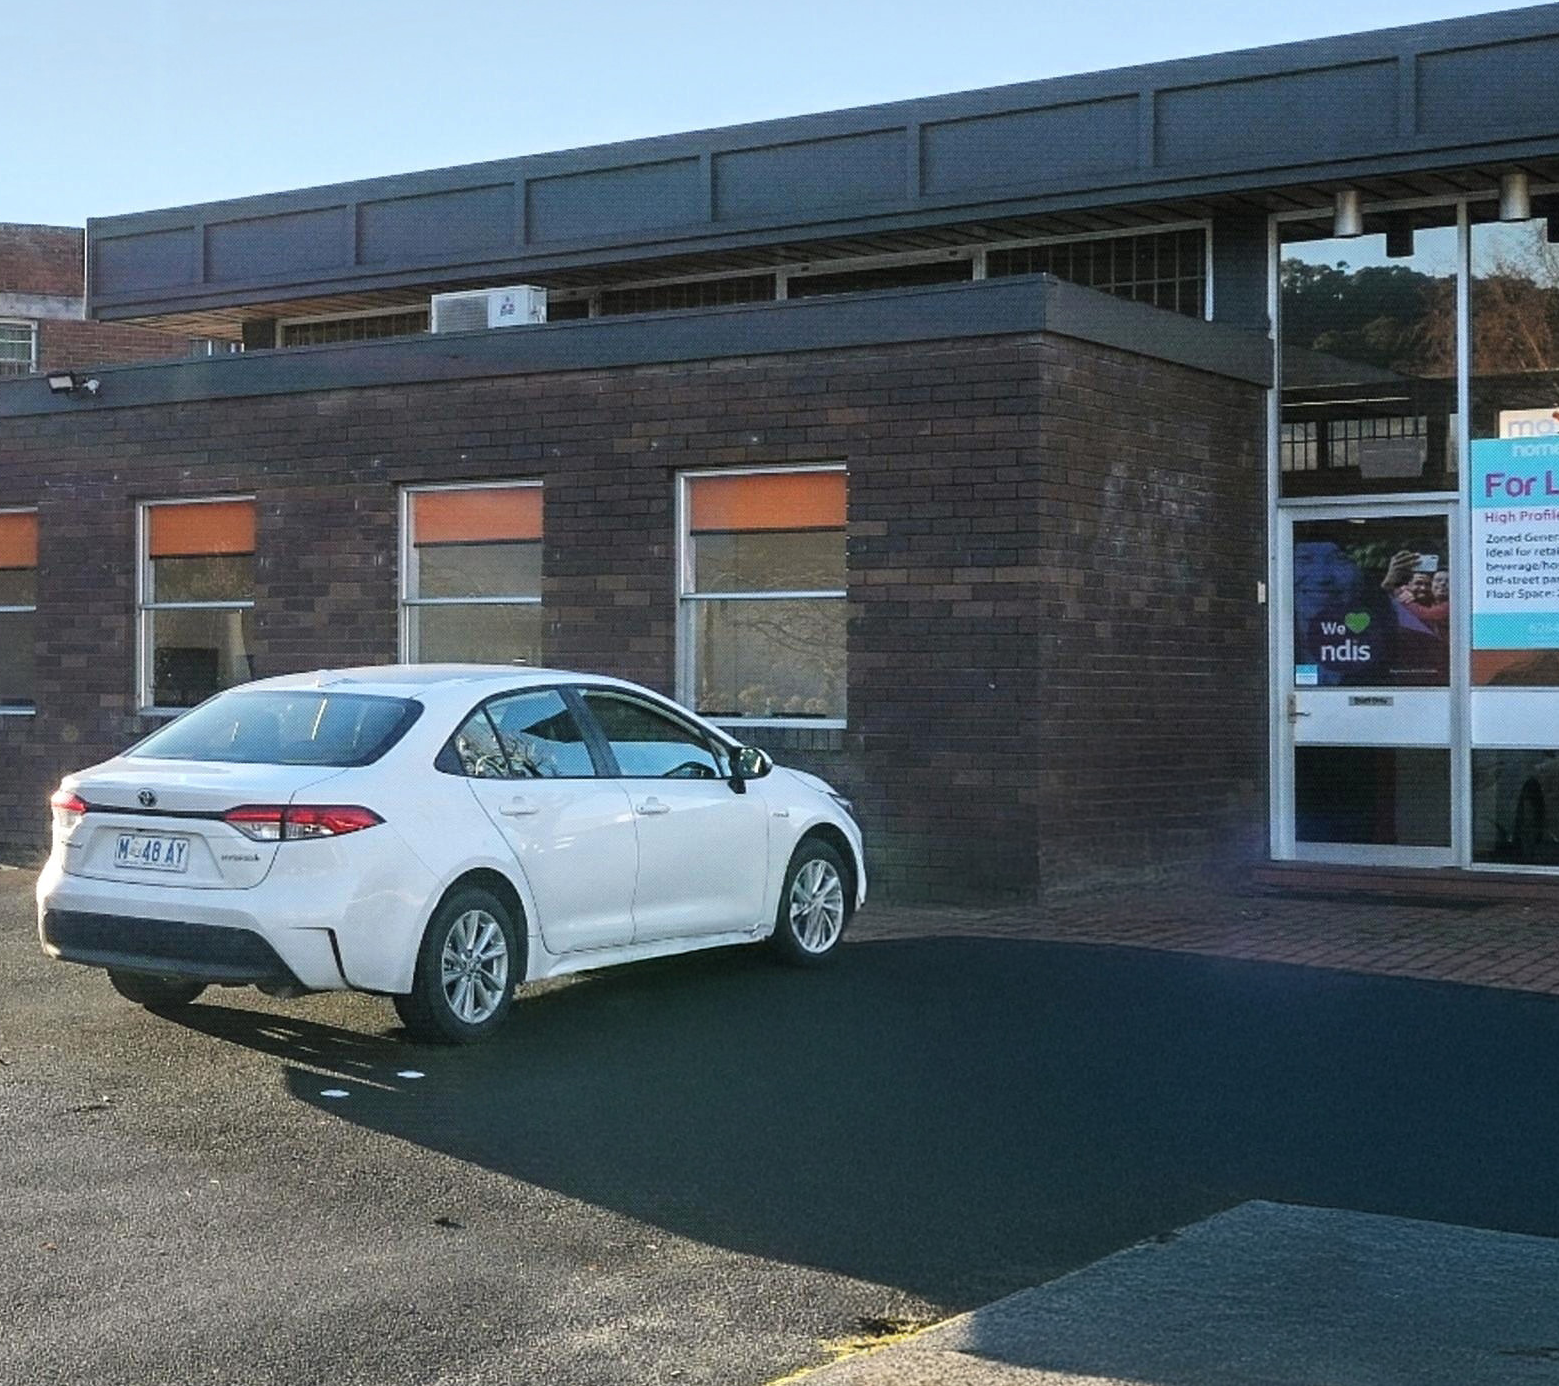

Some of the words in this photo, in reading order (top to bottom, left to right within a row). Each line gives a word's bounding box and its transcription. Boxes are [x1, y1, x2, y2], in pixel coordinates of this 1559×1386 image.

[1484, 472, 1537, 498] For
[1485, 511, 1516, 524] High
[1485, 533, 1522, 544] Zoned
[1515, 547, 1531, 557] for
[1485, 575, 1540, 585] Off-street
[1485, 589, 1515, 599] Floor
[1517, 588, 1555, 600] Space:
[1321, 622, 1347, 635] We
[1321, 639, 1371, 661] ndis
[117, 835, 129, 859] M
[142, 840, 161, 862] 48
[164, 840, 187, 863] AY
